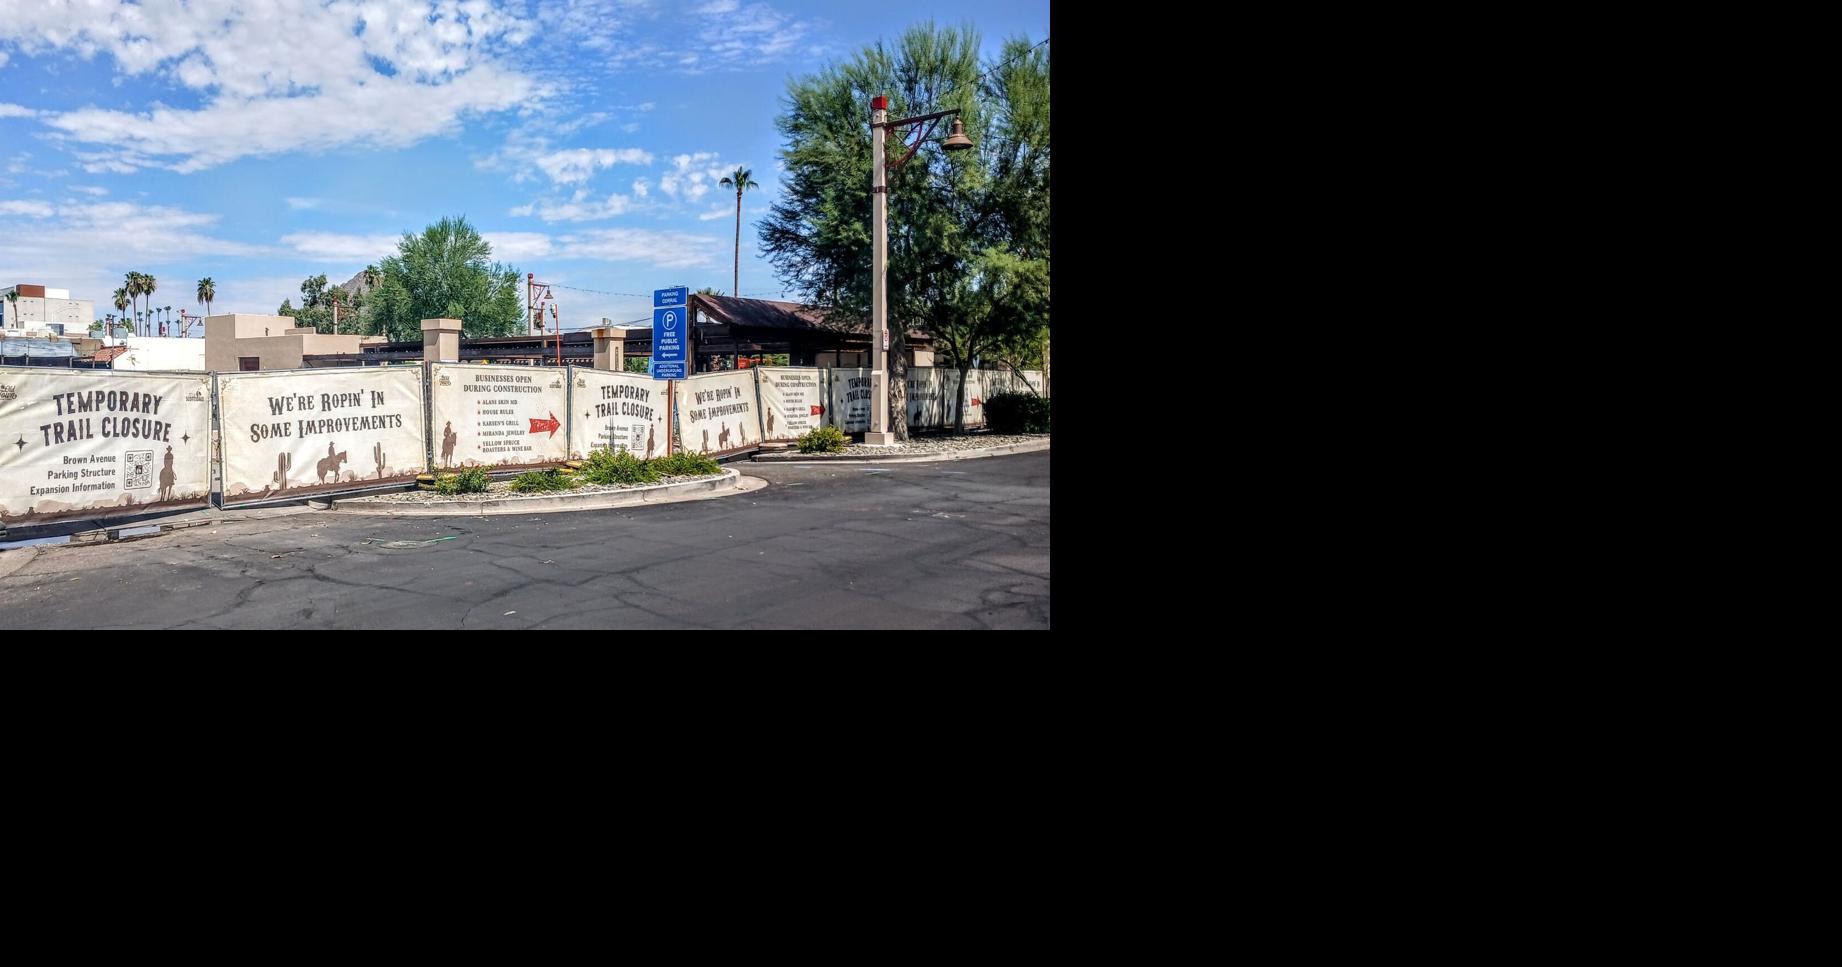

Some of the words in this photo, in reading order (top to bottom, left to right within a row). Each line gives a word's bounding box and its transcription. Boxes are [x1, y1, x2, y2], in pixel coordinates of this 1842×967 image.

[475, 374, 514, 383] BUSINESSES
[463, 384, 491, 393] DURING
[493, 385, 543, 394] CONSTRUCTION
[601, 384, 650, 403] TEMPORARY
[846, 390, 860, 403] TRAIL
[53, 390, 163, 416] TEMPORARY
[595, 402, 619, 418] TRAIL
[621, 402, 654, 421] CLOSURE
[689, 408, 707, 423] SOME
[708, 402, 749, 420] IMPROVEMENTS
[40, 418, 93, 446] TRAIL
[102, 417, 171, 443] CLOSURE
[250, 421, 292, 443] SOME
[299, 414, 402, 438] IMPROVEMENTS
[63, 455, 87, 465] Brown
[90, 454, 116, 463] Avenue
[48, 470, 78, 480] Parking
[81, 468, 116, 477] Structure
[30, 486, 70, 496] Expansion
[72, 481, 115, 492] Information
